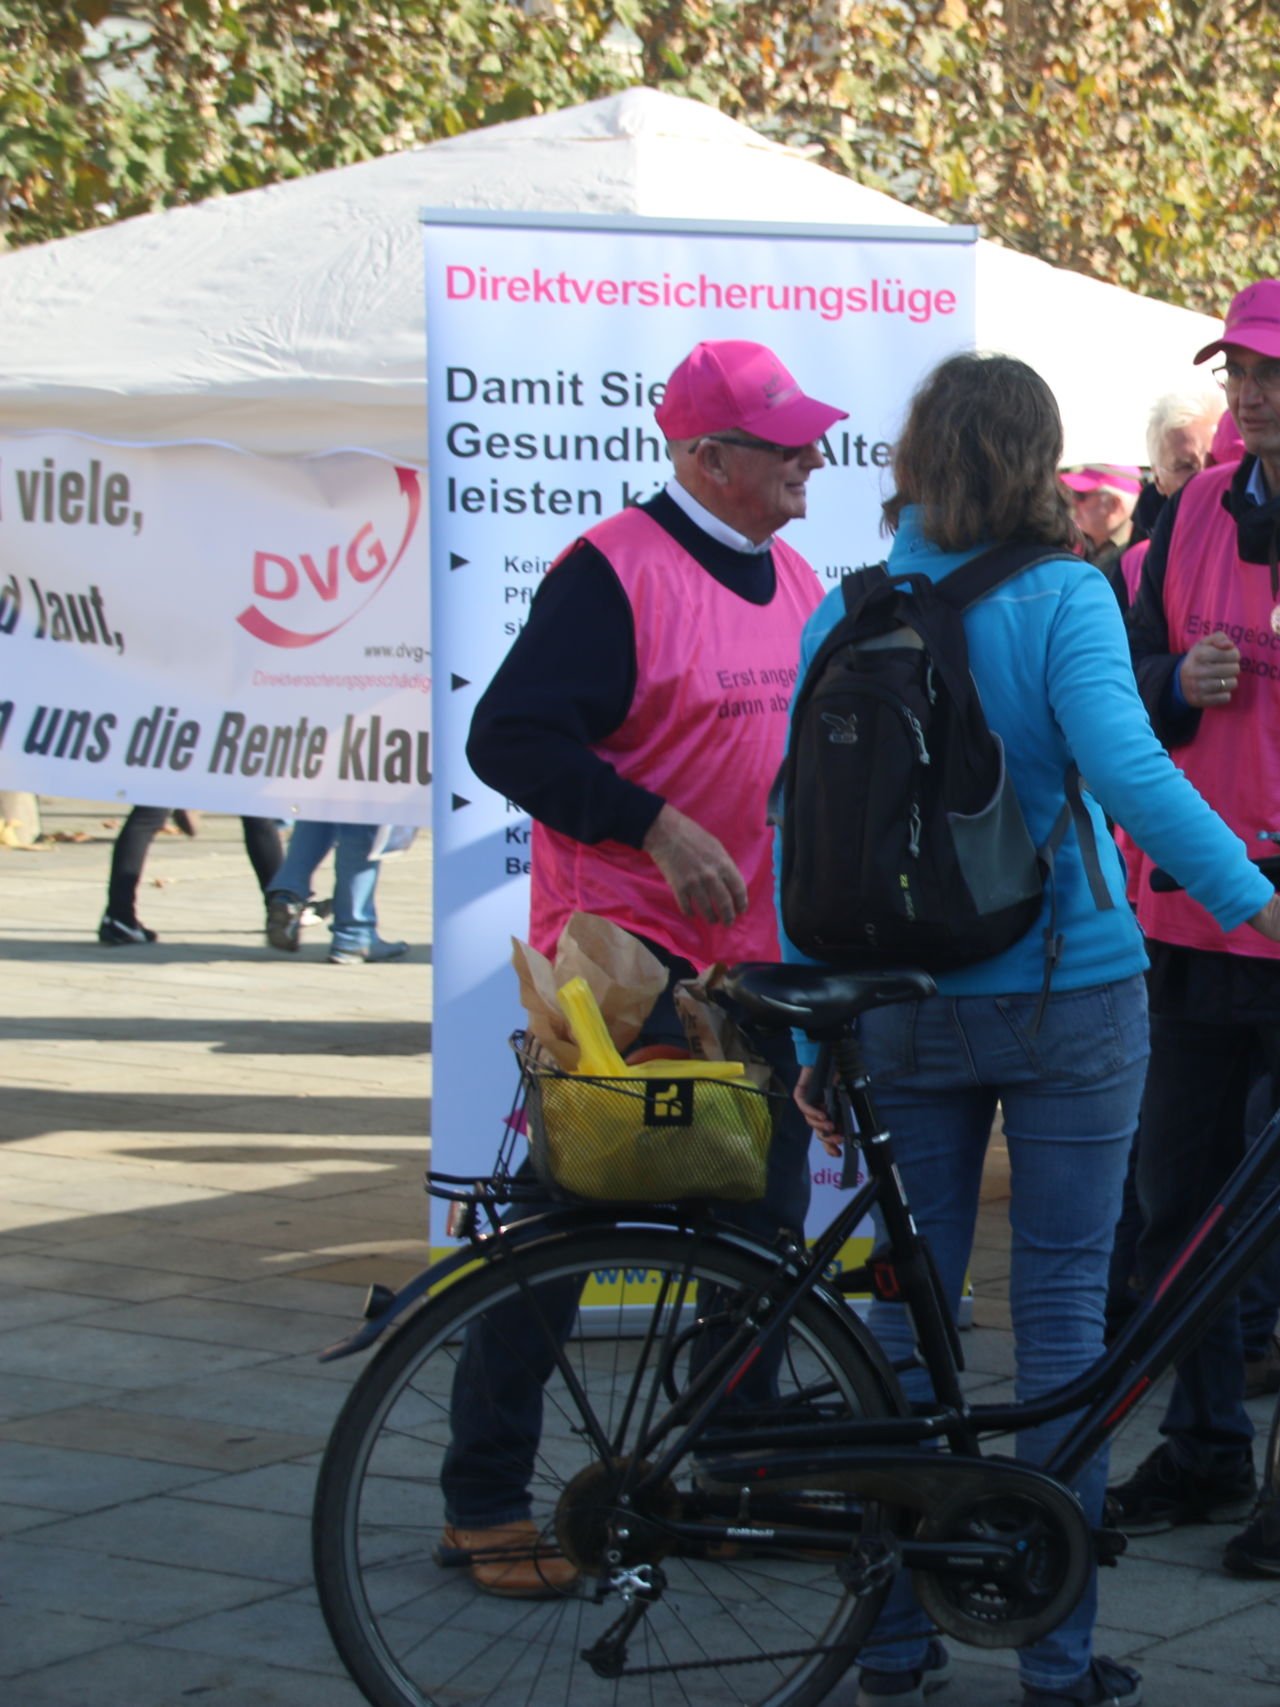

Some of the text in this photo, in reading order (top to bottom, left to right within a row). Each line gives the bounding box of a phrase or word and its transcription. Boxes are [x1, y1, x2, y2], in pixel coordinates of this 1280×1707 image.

[445, 264, 957, 323] Direktversicherungslüge
[446, 366, 667, 408] Damit Sie
[446, 421, 672, 463] Gesundh
[16, 457, 143, 537] viele,
[447, 477, 603, 516] leisten
[253, 519, 389, 603] DVG
[28, 576, 125, 655] laut,
[716, 668, 757, 689] Erst
[717, 693, 792, 719] dann ab
[22, 704, 118, 764] uns
[124, 704, 201, 772] die
[207, 710, 328, 779] Rente
